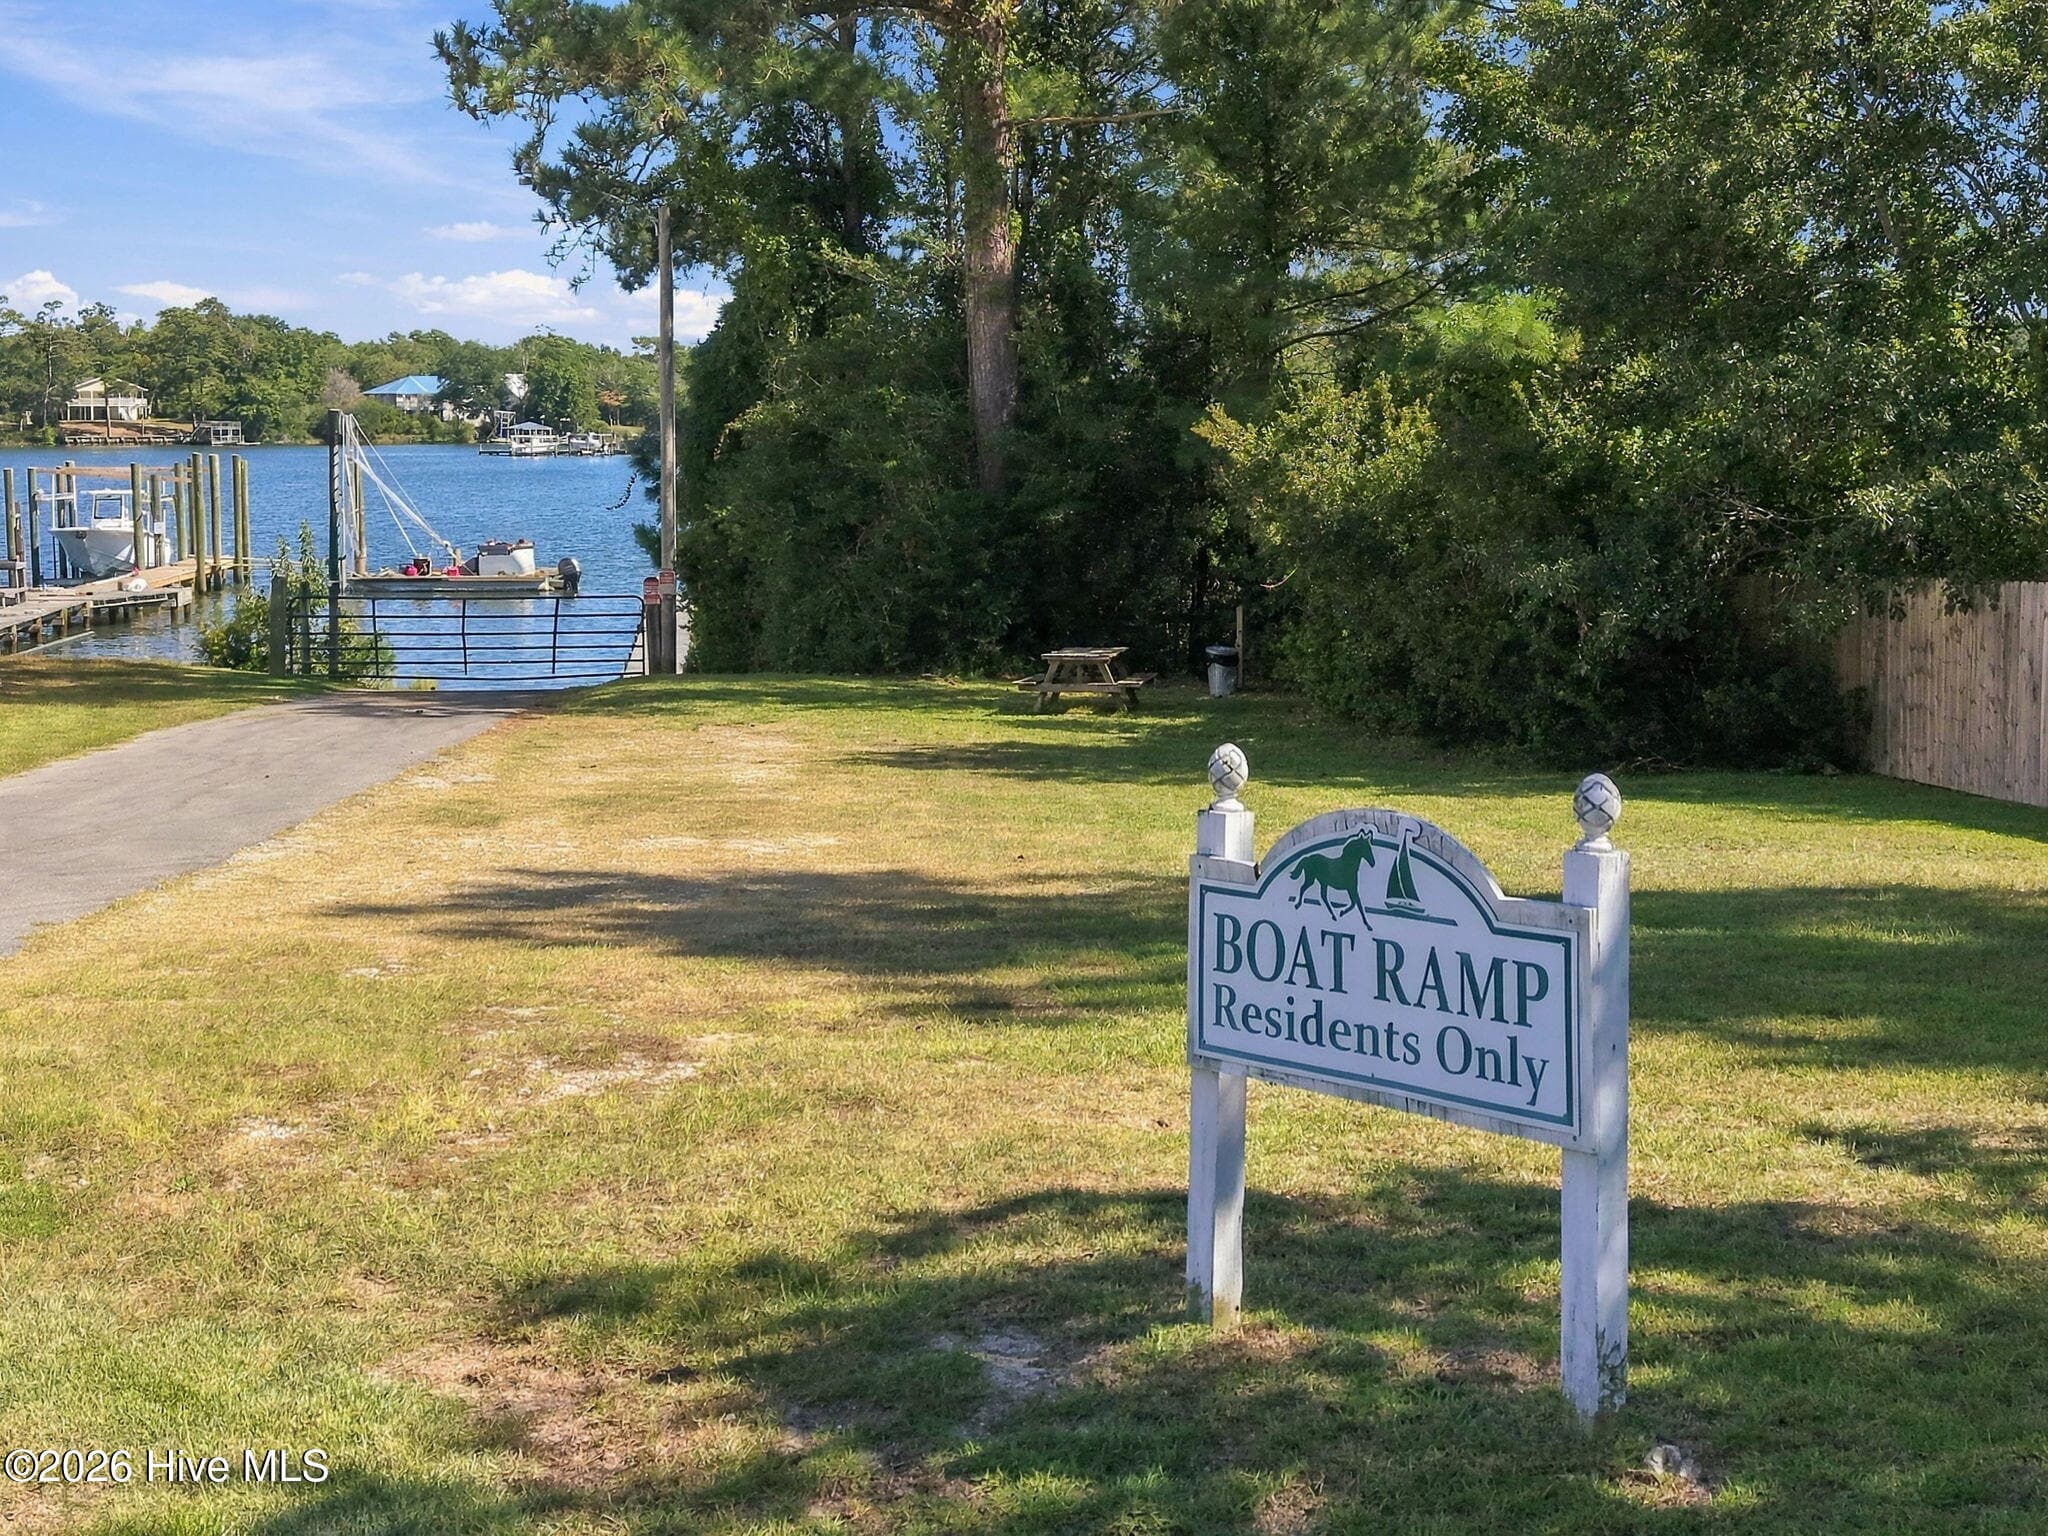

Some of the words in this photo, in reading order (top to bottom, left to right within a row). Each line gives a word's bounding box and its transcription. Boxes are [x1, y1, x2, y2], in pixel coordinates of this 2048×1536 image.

[1212, 912, 1356, 995] BOAT
[1372, 937, 1550, 1028] RAMP
[1212, 982, 1421, 1066] Residents
[1436, 1025, 1550, 1106] Only
